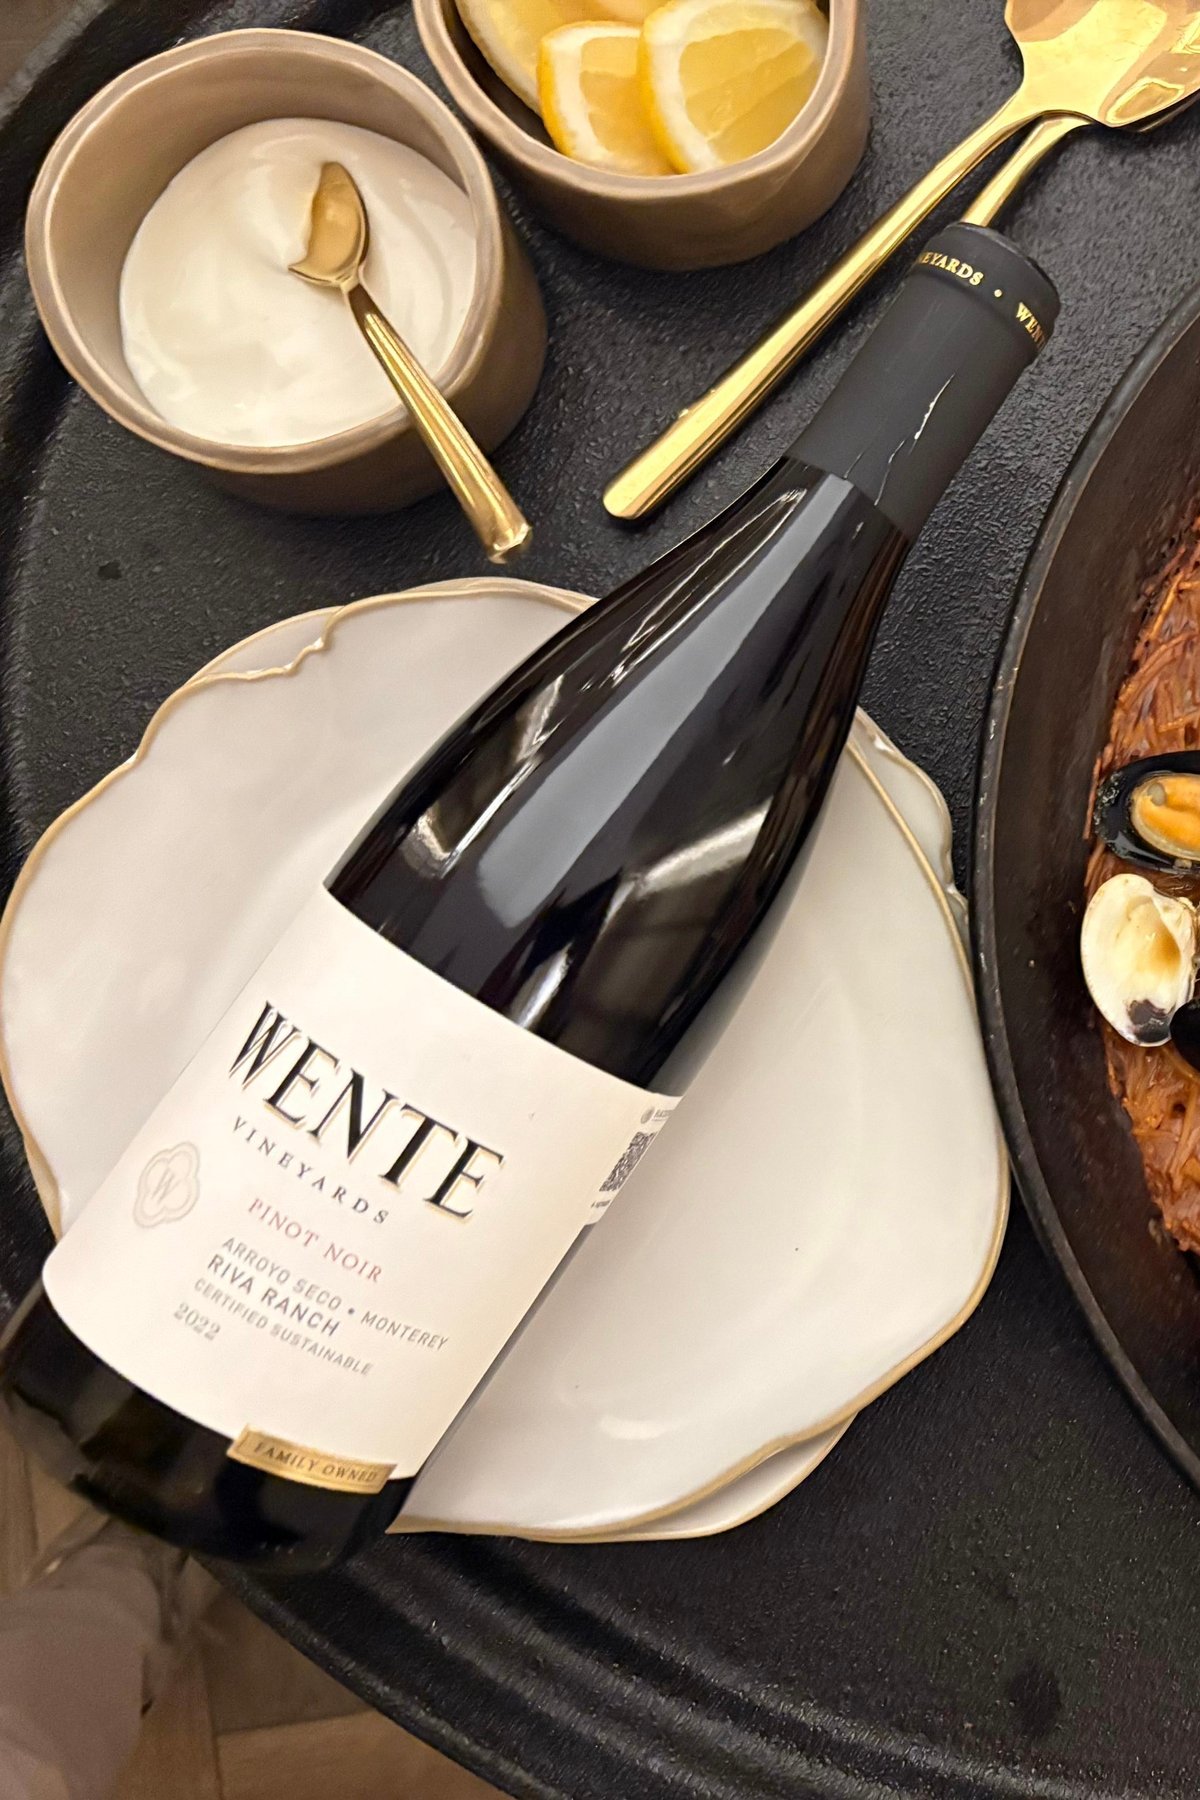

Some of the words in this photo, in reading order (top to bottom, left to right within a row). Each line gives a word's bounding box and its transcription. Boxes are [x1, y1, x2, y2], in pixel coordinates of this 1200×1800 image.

[229, 1000, 505, 1221] WENTE
[232, 1116, 390, 1225] VINEYARDS
[248, 1198, 319, 1248] PINOT
[323, 1243, 383, 1284] NOIR
[172, 1301, 222, 1342] 2022
[193, 1277, 269, 1330] CERTIFIED
[269, 1322, 375, 1377] SUSTAINABLE
[206, 1253, 256, 1296] RIVA
[260, 1287, 341, 1337] RANCH
[221, 1236, 291, 1285] ARROYO
[292, 1278, 343, 1312] SECO
[360, 1310, 449, 1352] MONTEREY
[253, 1441, 320, 1473] FAMILY
[321, 1463, 379, 1483] OWNED
